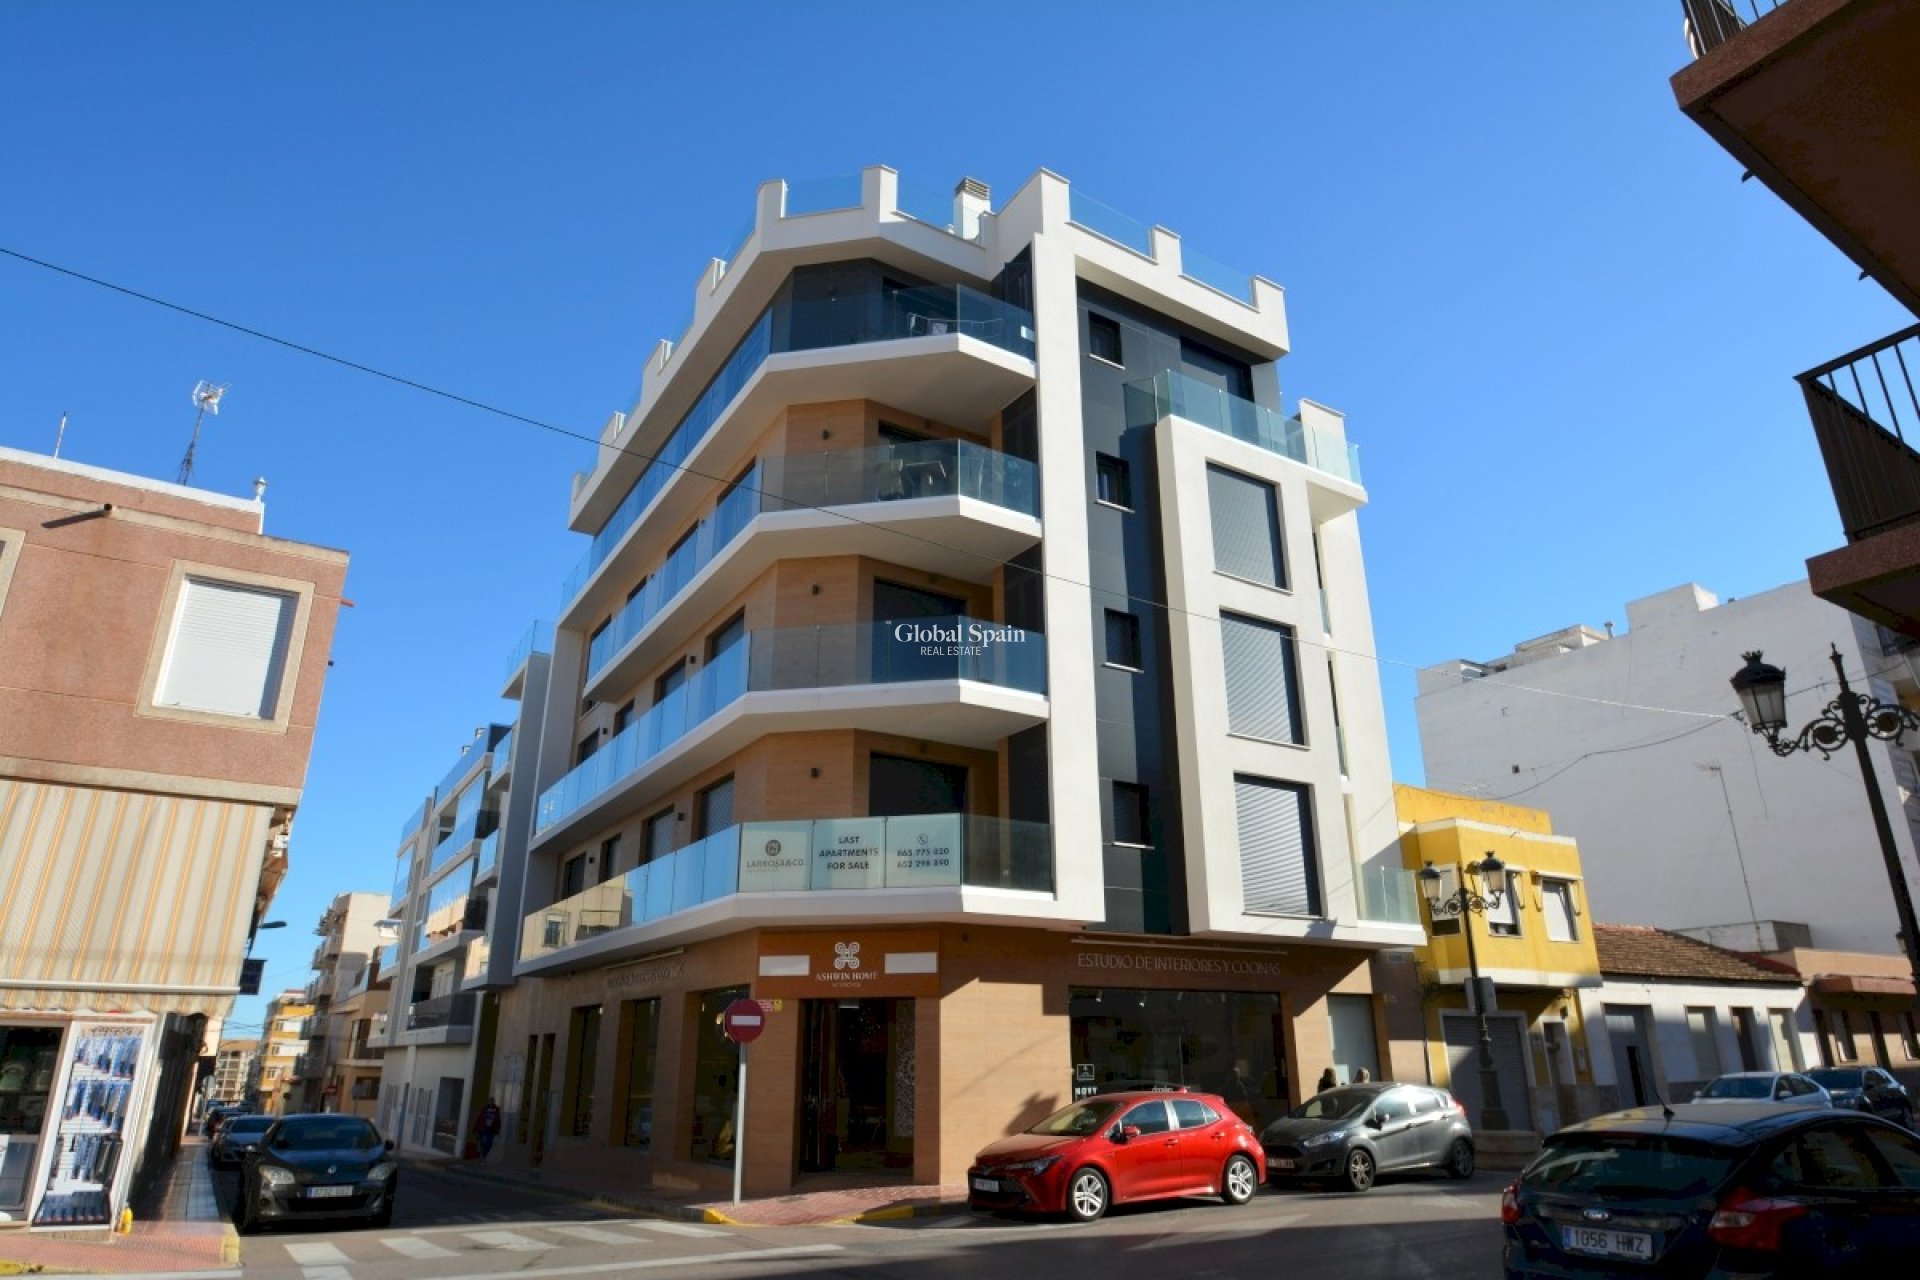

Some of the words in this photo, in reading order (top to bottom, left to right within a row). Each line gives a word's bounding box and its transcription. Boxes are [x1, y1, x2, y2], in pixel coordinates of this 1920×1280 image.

[838, 836, 860, 845] LAST
[818, 848, 880, 857] APARTMENTS
[826, 861, 846, 870] FOR
[848, 861, 870, 870] SALE
[1077, 953, 1133, 969] ESTUDIO
[1135, 956, 1153, 970] DE
[1154, 957, 1222, 973] INTERIORES
[1231, 961, 1281, 976] COCINAS
[1575, 1229, 1608, 1249] 1056
